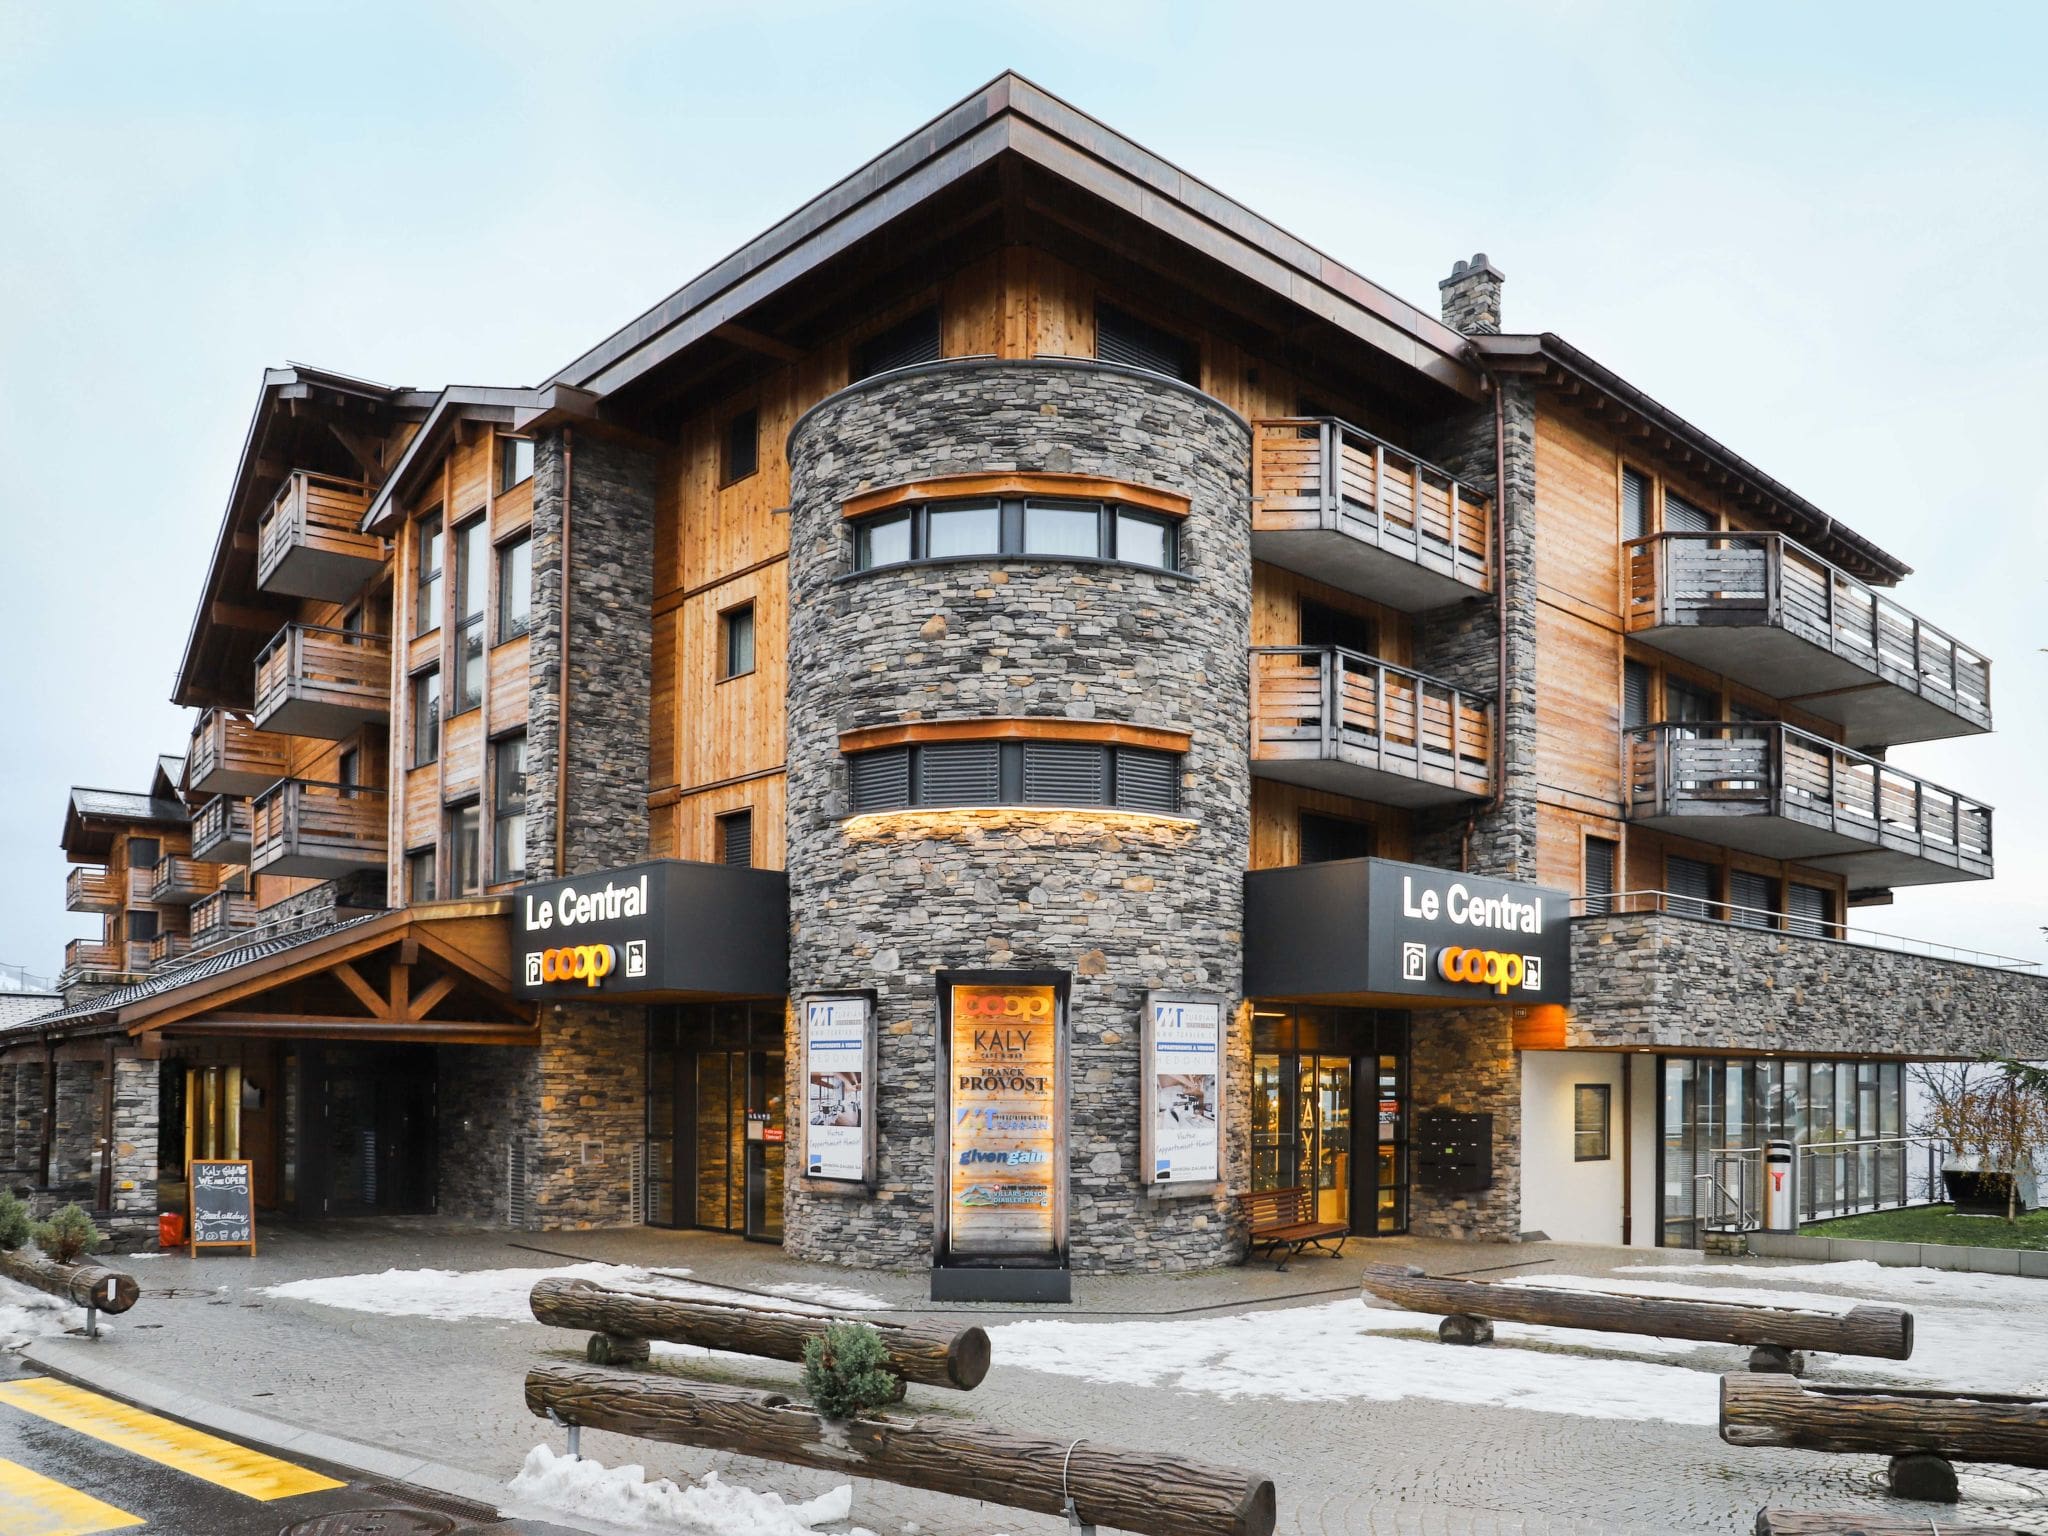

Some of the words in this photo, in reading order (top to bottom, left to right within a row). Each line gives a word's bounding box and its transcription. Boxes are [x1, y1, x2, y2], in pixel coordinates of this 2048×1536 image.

[526, 895, 553, 931] Le
[558, 875, 648, 927] Central
[1403, 876, 1440, 921] Le
[1447, 883, 1542, 935] Central
[543, 943, 614, 988] coop
[1438, 946, 1523, 995] coop
[960, 995, 1050, 1022] coop
[974, 1028, 1032, 1051] KALY
[959, 1076, 1048, 1092] PROVOST
[981, 1068, 1025, 1077] FRANCK
[198, 1176, 213, 1185] WE
